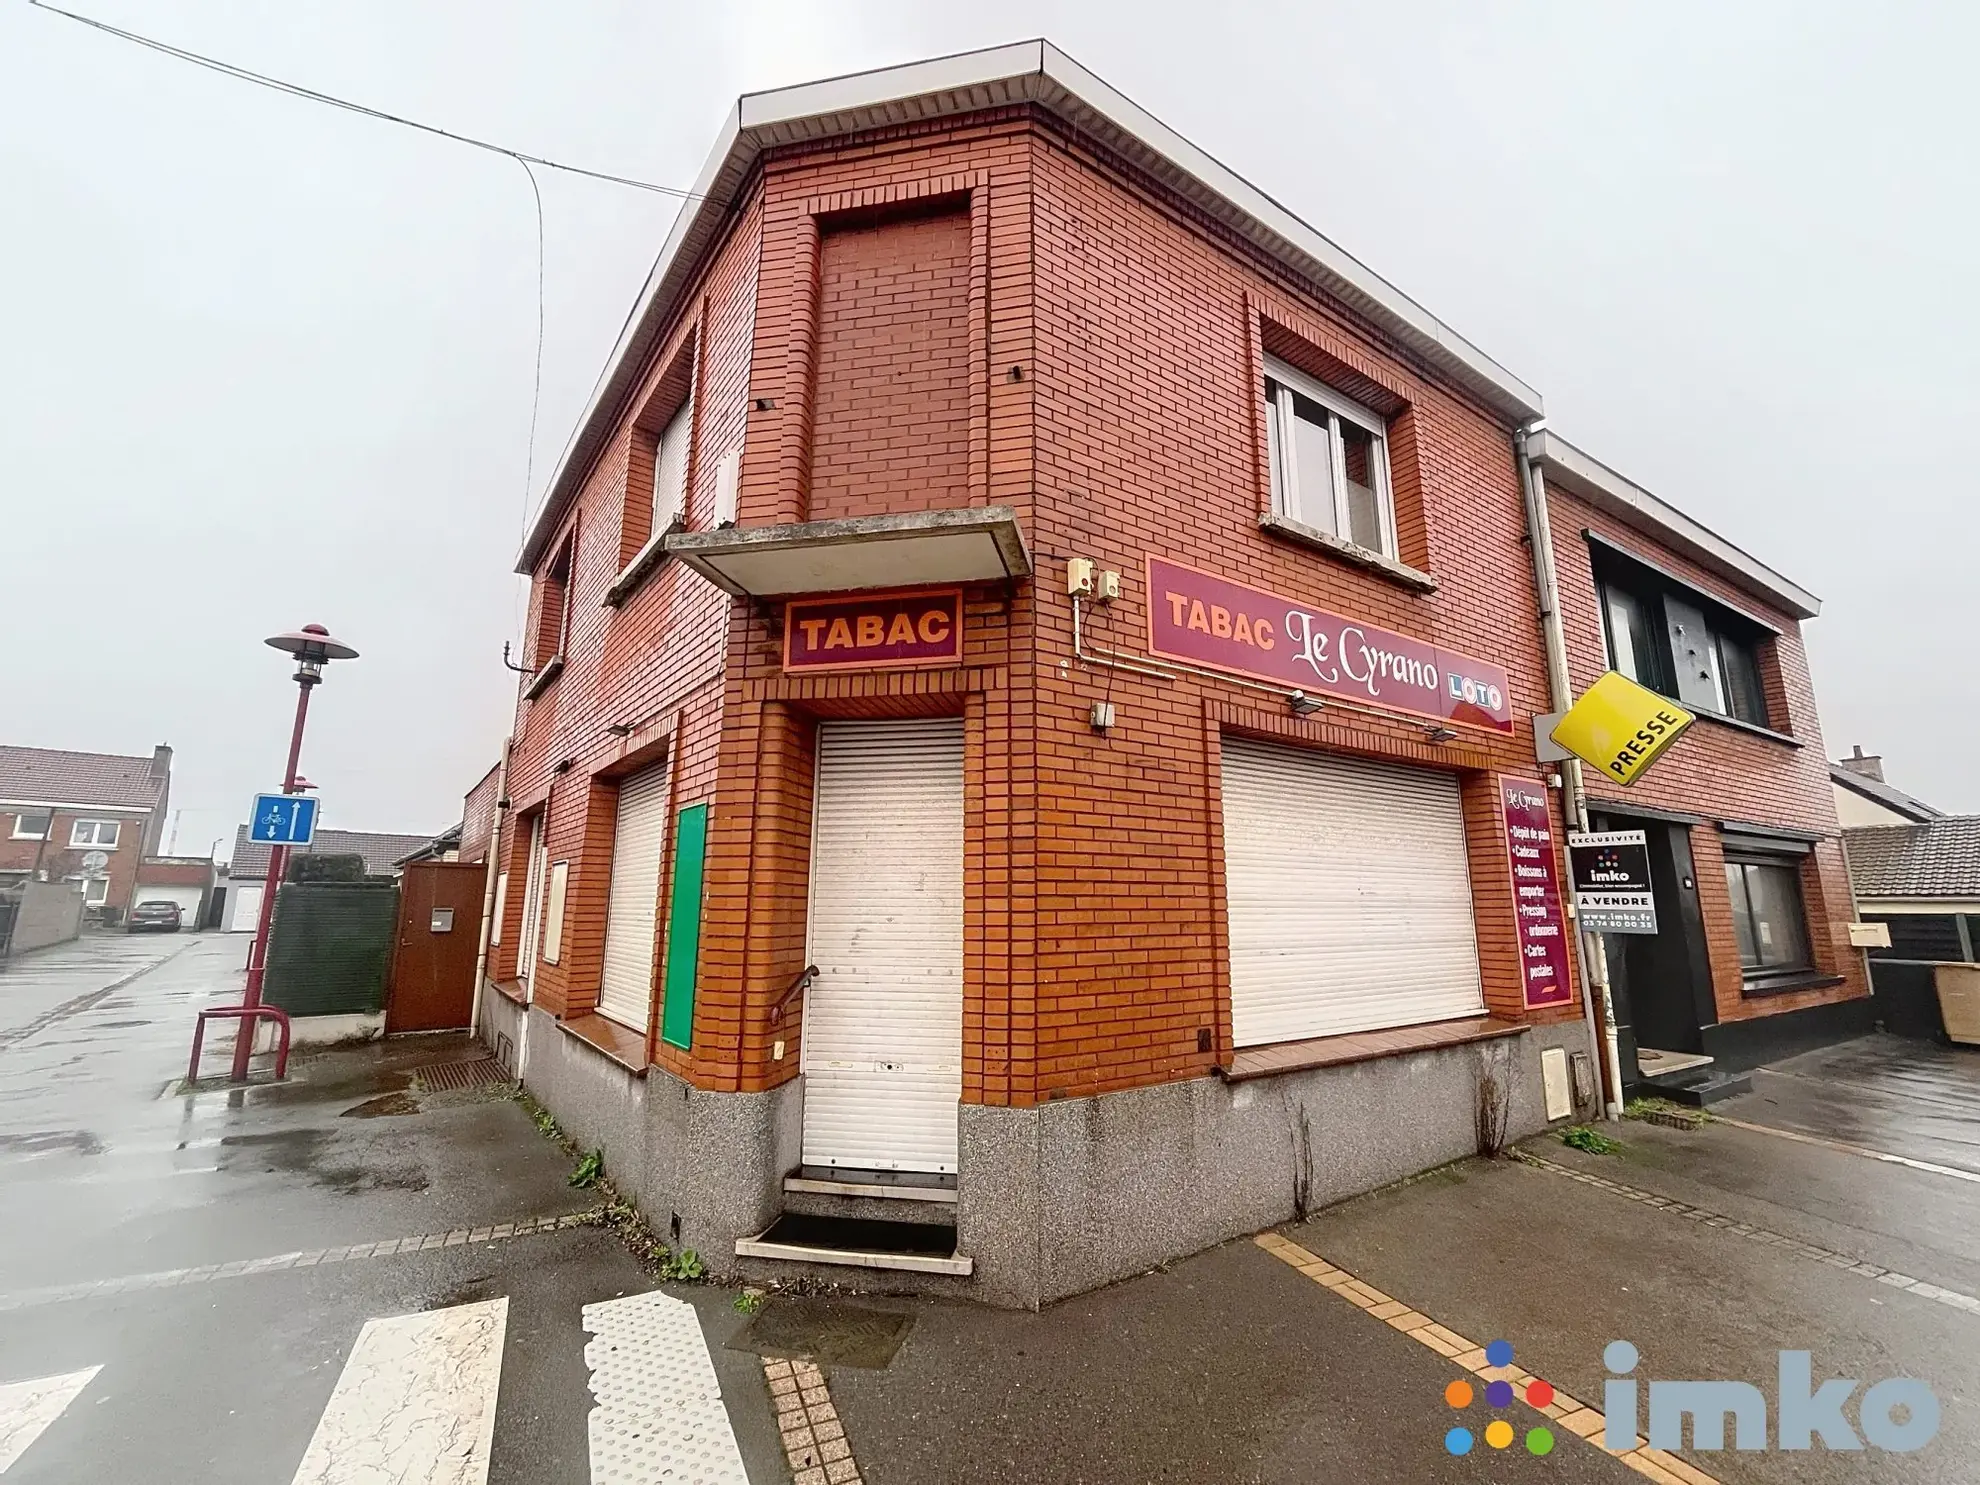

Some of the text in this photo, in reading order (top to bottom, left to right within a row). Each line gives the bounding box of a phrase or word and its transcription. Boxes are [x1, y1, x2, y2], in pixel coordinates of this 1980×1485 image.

[800, 610, 950, 651] TABAC
[1165, 591, 1502, 711] TABAC Le Cyrano LOTO
[1609, 711, 1679, 776] PRESSE
[1506, 788, 1545, 811] Le Cyrano
[1530, 827, 1538, 839] de
[1538, 829, 1550, 842] pain
[1571, 834, 1641, 844] EXCLUSIVITÉ
[1515, 844, 1540, 858] Cadeaux
[1517, 864, 1542, 878] Boissons
[1590, 869, 1630, 882] imko
[1519, 885, 1545, 899] emporter
[1593, 897, 1649, 906] VENDRE
[1521, 904, 1547, 918] Pressing
[1583, 912, 1651, 921] www.imko.fr
[1527, 944, 1546, 957] Cartes
[1530, 964, 1553, 980] postales
